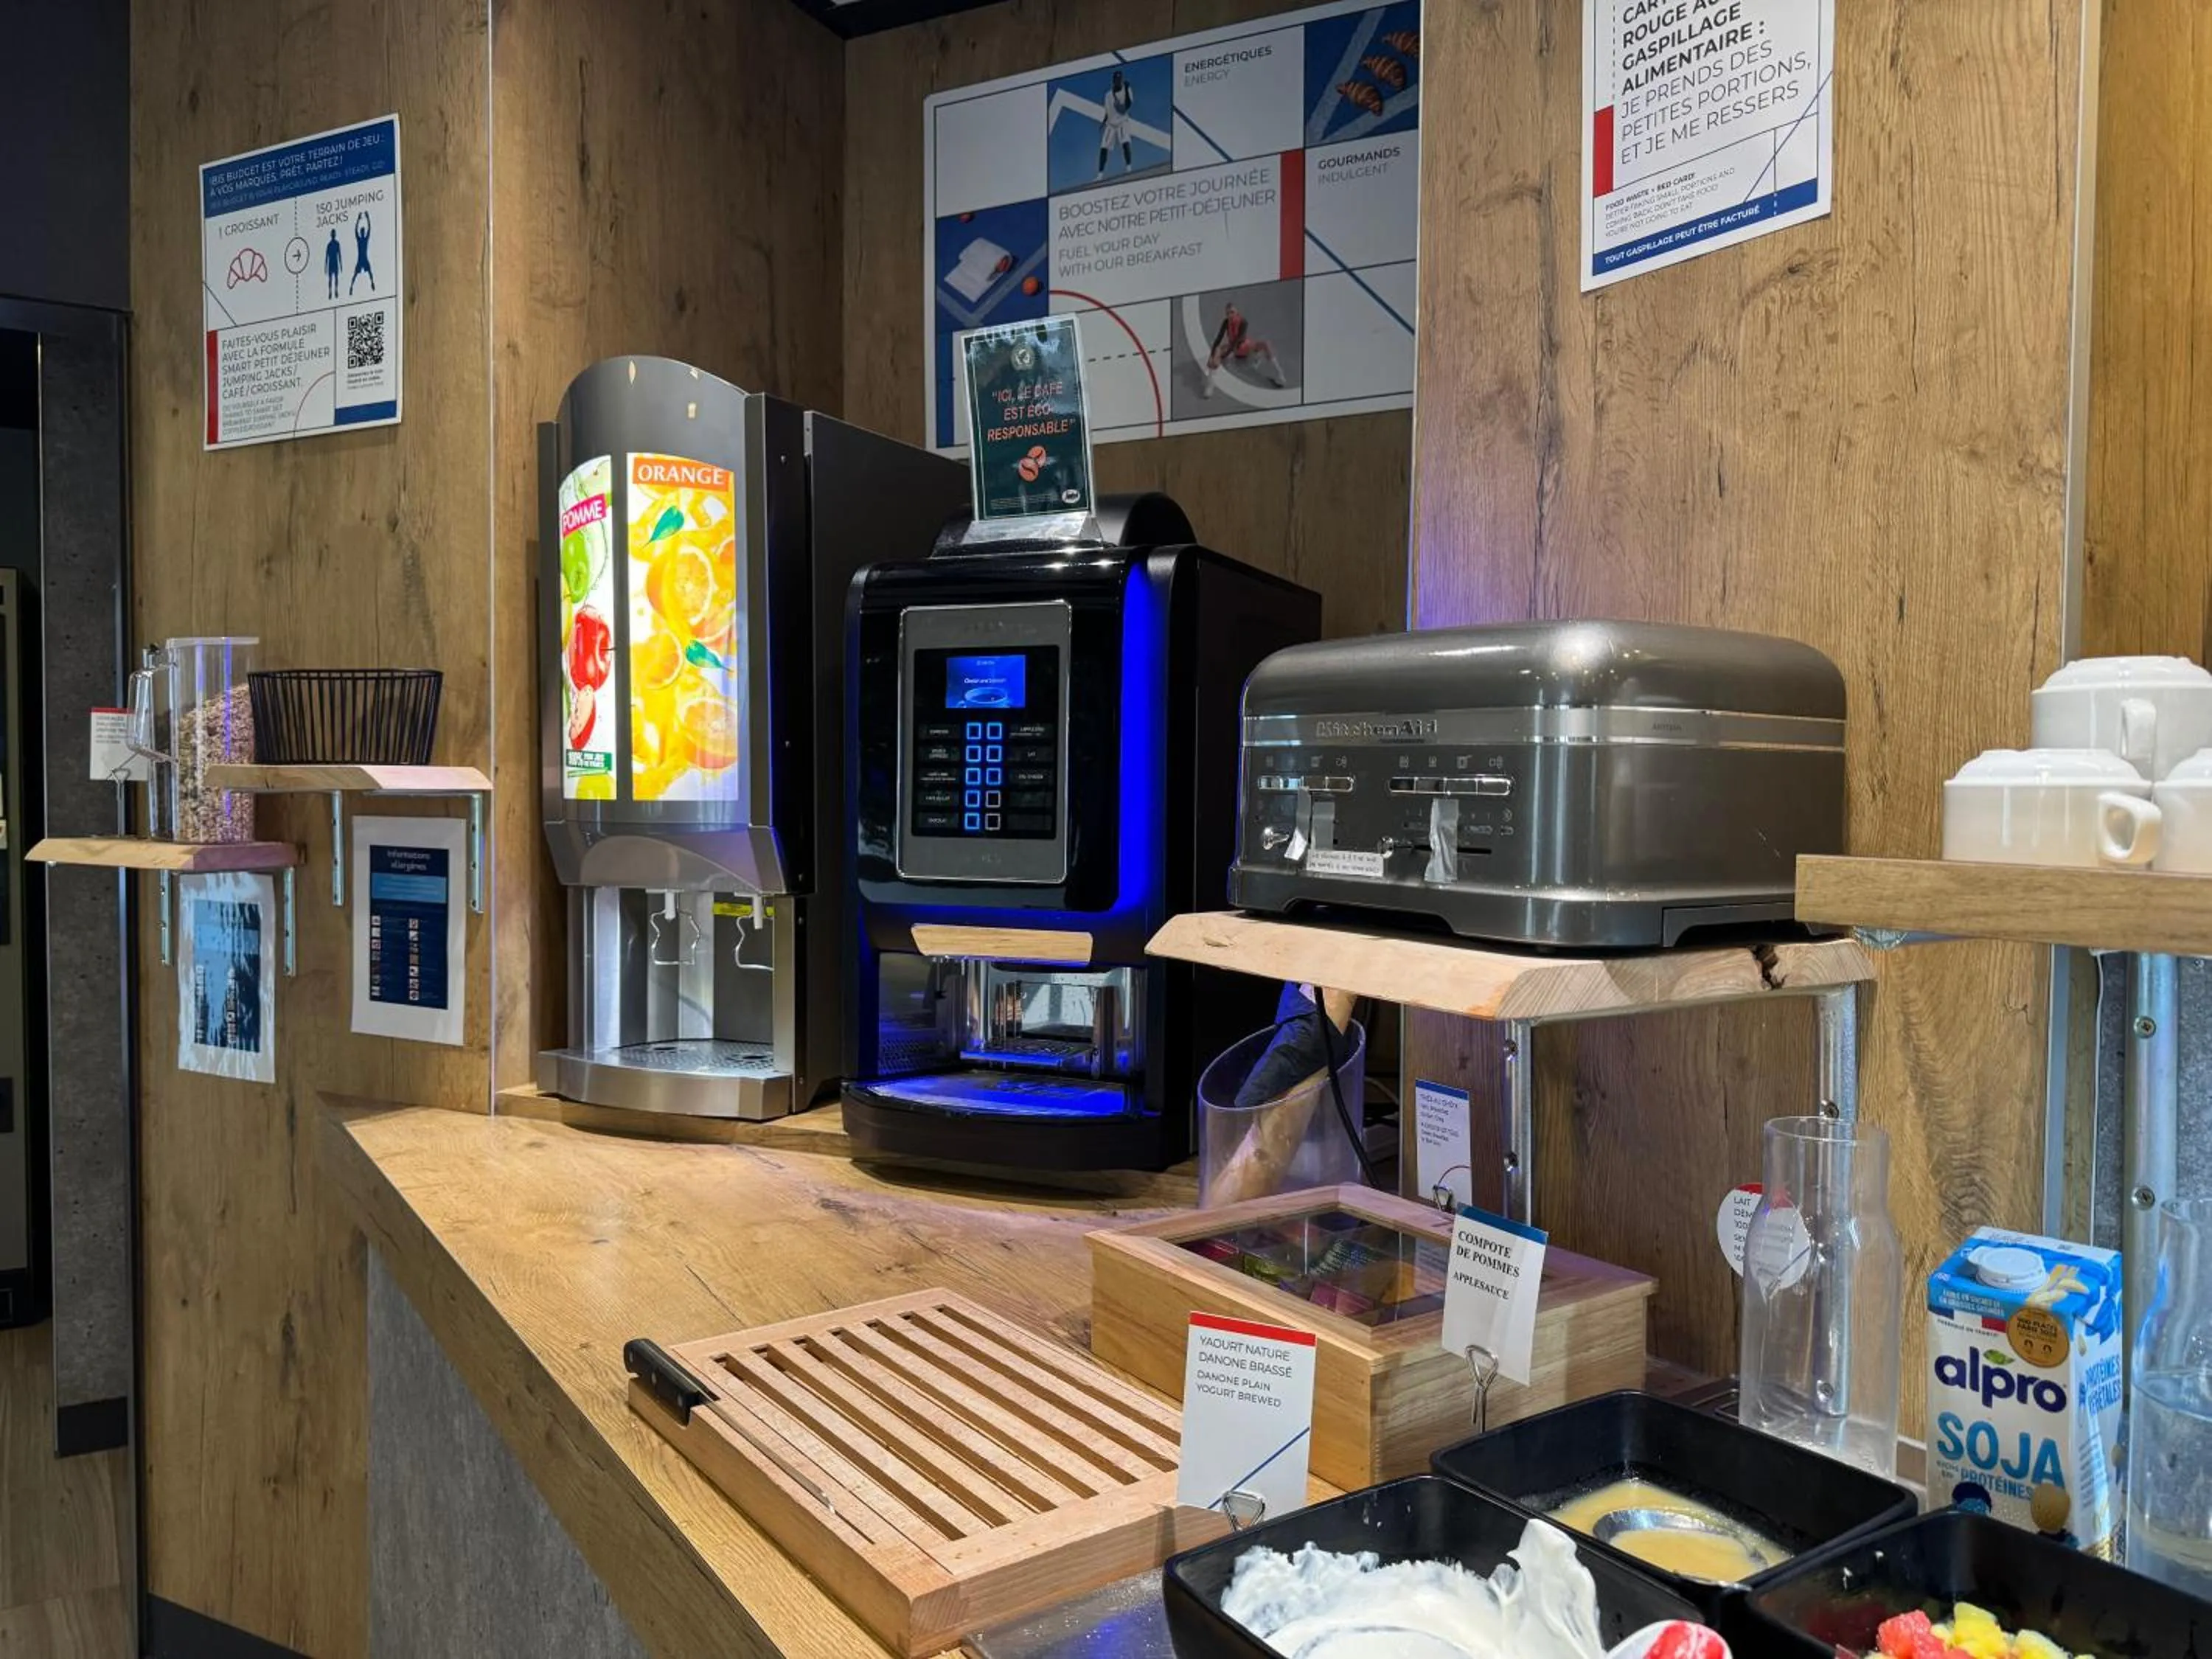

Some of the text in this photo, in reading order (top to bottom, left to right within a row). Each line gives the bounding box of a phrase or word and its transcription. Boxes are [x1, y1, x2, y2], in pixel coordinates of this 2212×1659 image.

[1622, 1, 1741, 71] GASPILLAGE
[1623, 2, 1688, 49] ROUGE
[1621, 22, 1753, 96] ALIMENTAIRE
[1184, 69, 1230, 87] ENERGY
[1621, 40, 1773, 119] JE PRENDS DES
[1622, 52, 1811, 141] PETITES PORTIONS,
[1621, 80, 1799, 164] ET JE ME RESSERS
[226, 164, 260, 183] BUDGET
[262, 160, 276, 173] EST
[278, 153, 306, 167] VOTRE
[308, 142, 346, 160] TERRAIN
[347, 138, 361, 150] DE
[1318, 147, 1400, 170] GOURMANDS
[1318, 162, 1388, 184] INDULGENT
[1680, 175, 1718, 195] PORTIONS
[316, 189, 384, 215] 150 JUMPING
[1058, 168, 1271, 221] BOOSTEZ VOTRE JOURNÉE
[224, 213, 280, 236] CROISSANT
[316, 210, 349, 228] JACKS
[1058, 188, 1276, 240] AVEC NOTRE PETIT-DÉJEUNER
[1058, 233, 1160, 260] FUEL YOUR DAY
[1605, 251, 1625, 265] TOUT
[1626, 236, 1674, 259] GASPILLAGE
[1674, 228, 1697, 241] PEUT
[1719, 204, 1761, 226] FACTURÉ
[1058, 242, 1203, 278] WITH OUR BREAKFAST
[222, 322, 317, 349] FAITES-VOUS PLAISIR
[222, 338, 305, 363] AVEC LA FORMULE
[222, 361, 251, 375] SMART
[254, 355, 278, 369] PETIT
[222, 371, 262, 387] JUMPING
[1004, 406, 1026, 421] EST
[637, 462, 725, 486] ORANGE
[562, 499, 602, 530] POMME
[1734, 1197, 1751, 1206] LAIT
[1457, 1229, 1512, 1259] COMPOTE
[1456, 1245, 1520, 1279] DE POMMES
[1453, 1270, 1509, 1301] APPLESAUCE
[1198, 1352, 1247, 1370] DANONE
[1199, 1335, 1290, 1362] YAOURT NATURE
[1197, 1369, 1271, 1391] DANONE PLAIN
[1934, 1346, 2067, 1413] alpro
[1196, 1382, 1281, 1408] YOGURT BREWED
[1937, 1411, 2065, 1489] SOJA
